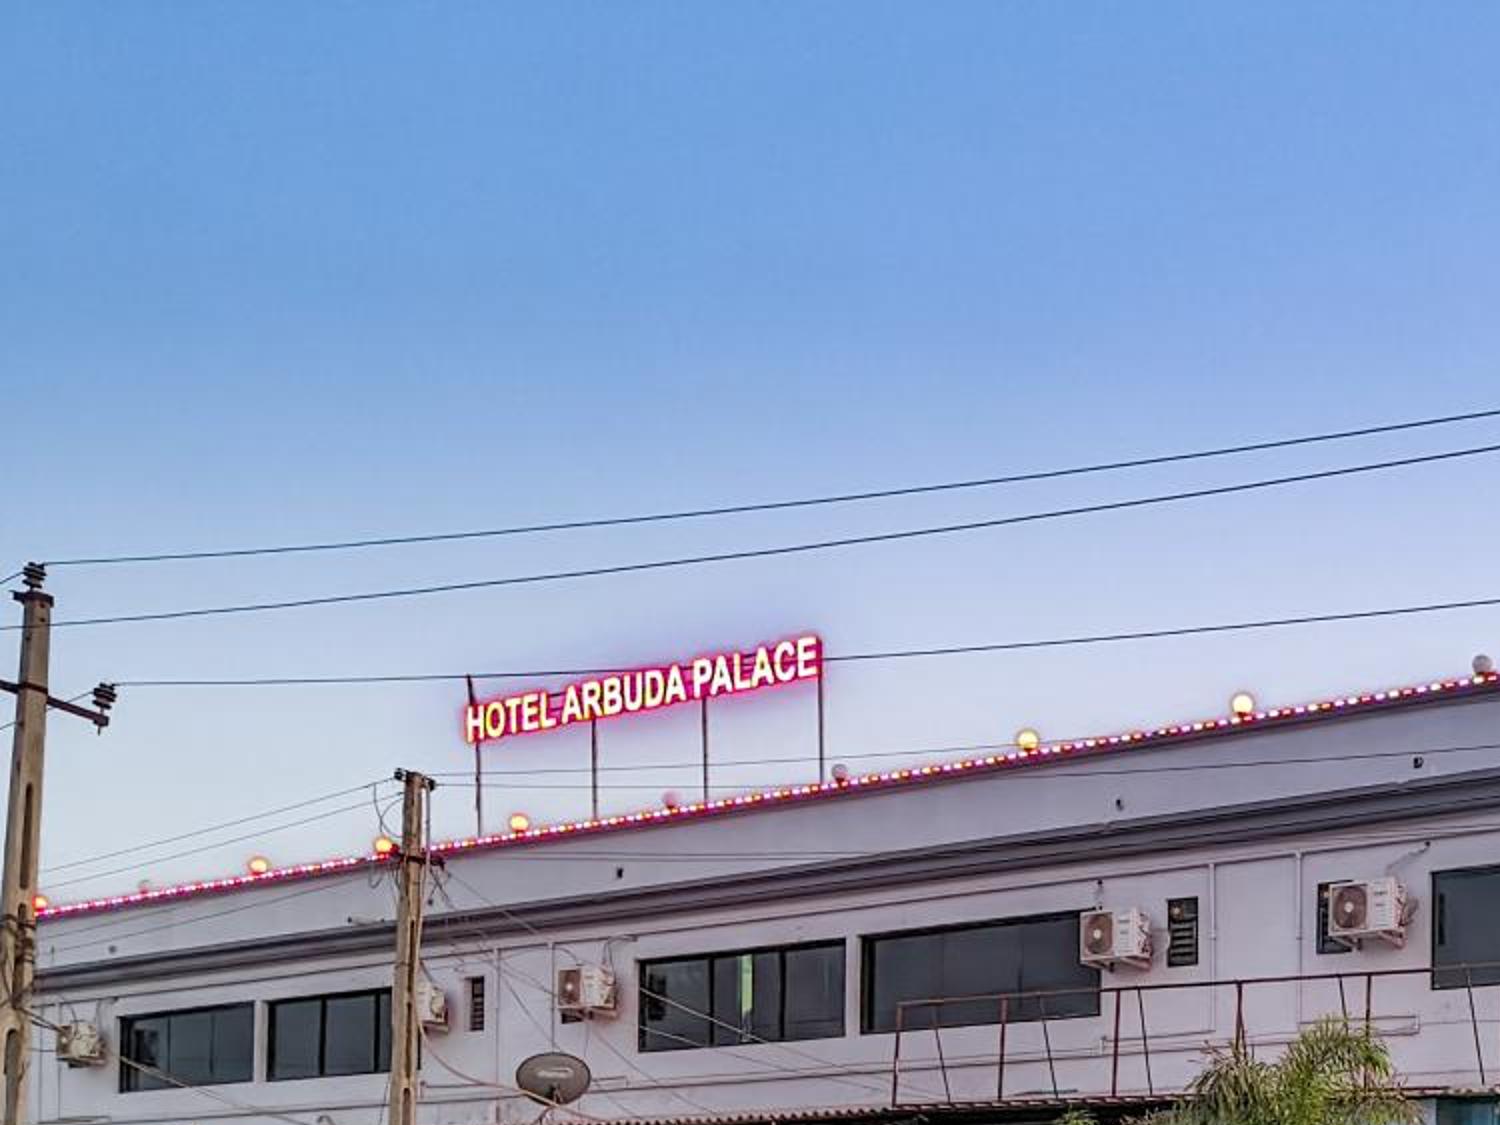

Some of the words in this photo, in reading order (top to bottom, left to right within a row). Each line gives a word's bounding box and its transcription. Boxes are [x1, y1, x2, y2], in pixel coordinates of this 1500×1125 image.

[466, 692, 557, 743] HOTEL
[562, 664, 687, 723] ARBUDA
[692, 636, 819, 699] PALACE
